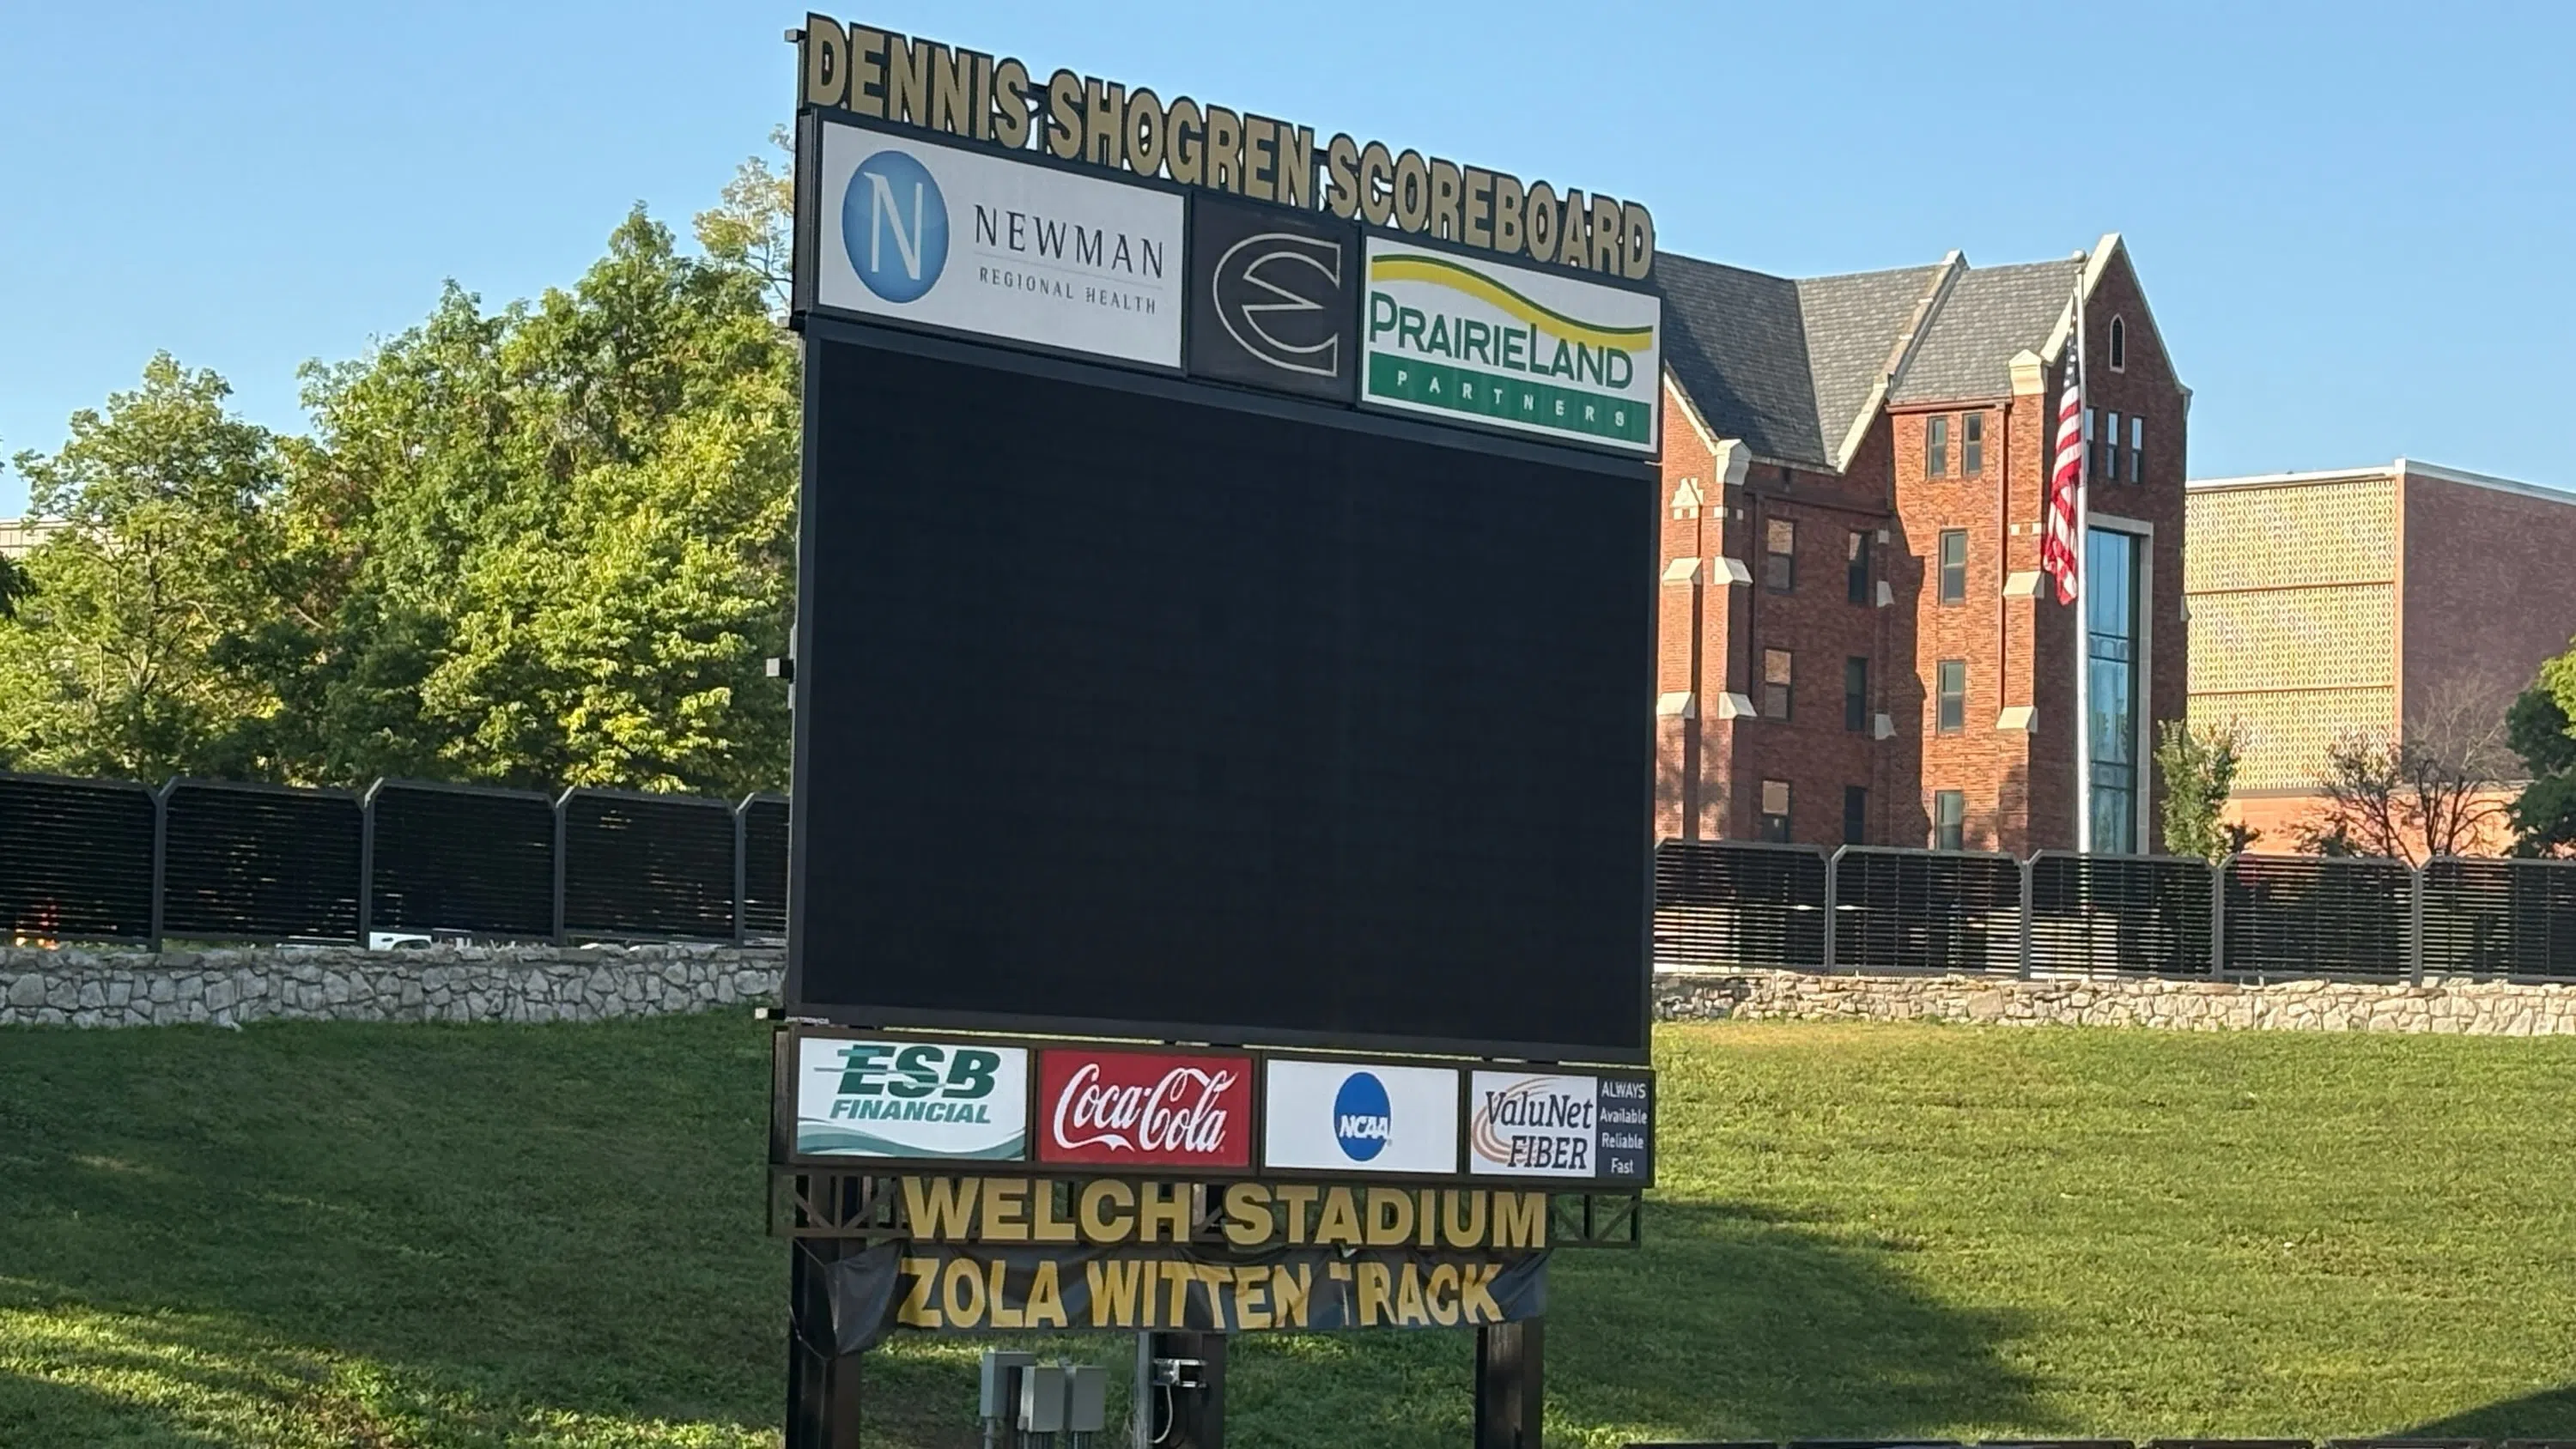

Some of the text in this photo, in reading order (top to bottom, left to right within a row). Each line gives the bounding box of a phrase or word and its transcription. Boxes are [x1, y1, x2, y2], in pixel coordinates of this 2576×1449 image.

[807, 12, 1656, 281] DENNIS SHOGREN SCOREBOARD
[864, 171, 923, 281] N
[974, 204, 1163, 279] NEWMAN
[979, 267, 1157, 315] REGIONAL HEALTH
[1396, 370, 1625, 427] PARTNERS
[835, 1043, 1001, 1100] ESB
[1601, 1081, 1646, 1099] ALWAYS
[829, 1100, 991, 1124] FINANCIAL
[1053, 1063, 1238, 1152] Coca-Cola
[1339, 1114, 1391, 1141] NCAA
[1485, 1090, 1593, 1130] ValuNet
[1600, 1106, 1648, 1125] Available
[1507, 1134, 1588, 1170] FIBER
[1601, 1132, 1644, 1149] Reliable
[1611, 1157, 1634, 1173] Fast
[902, 1175, 1546, 1248] WELCH STADIUM
[897, 1257, 1069, 1329] ZOLA
[1085, 1258, 1313, 1330] WITTEN
